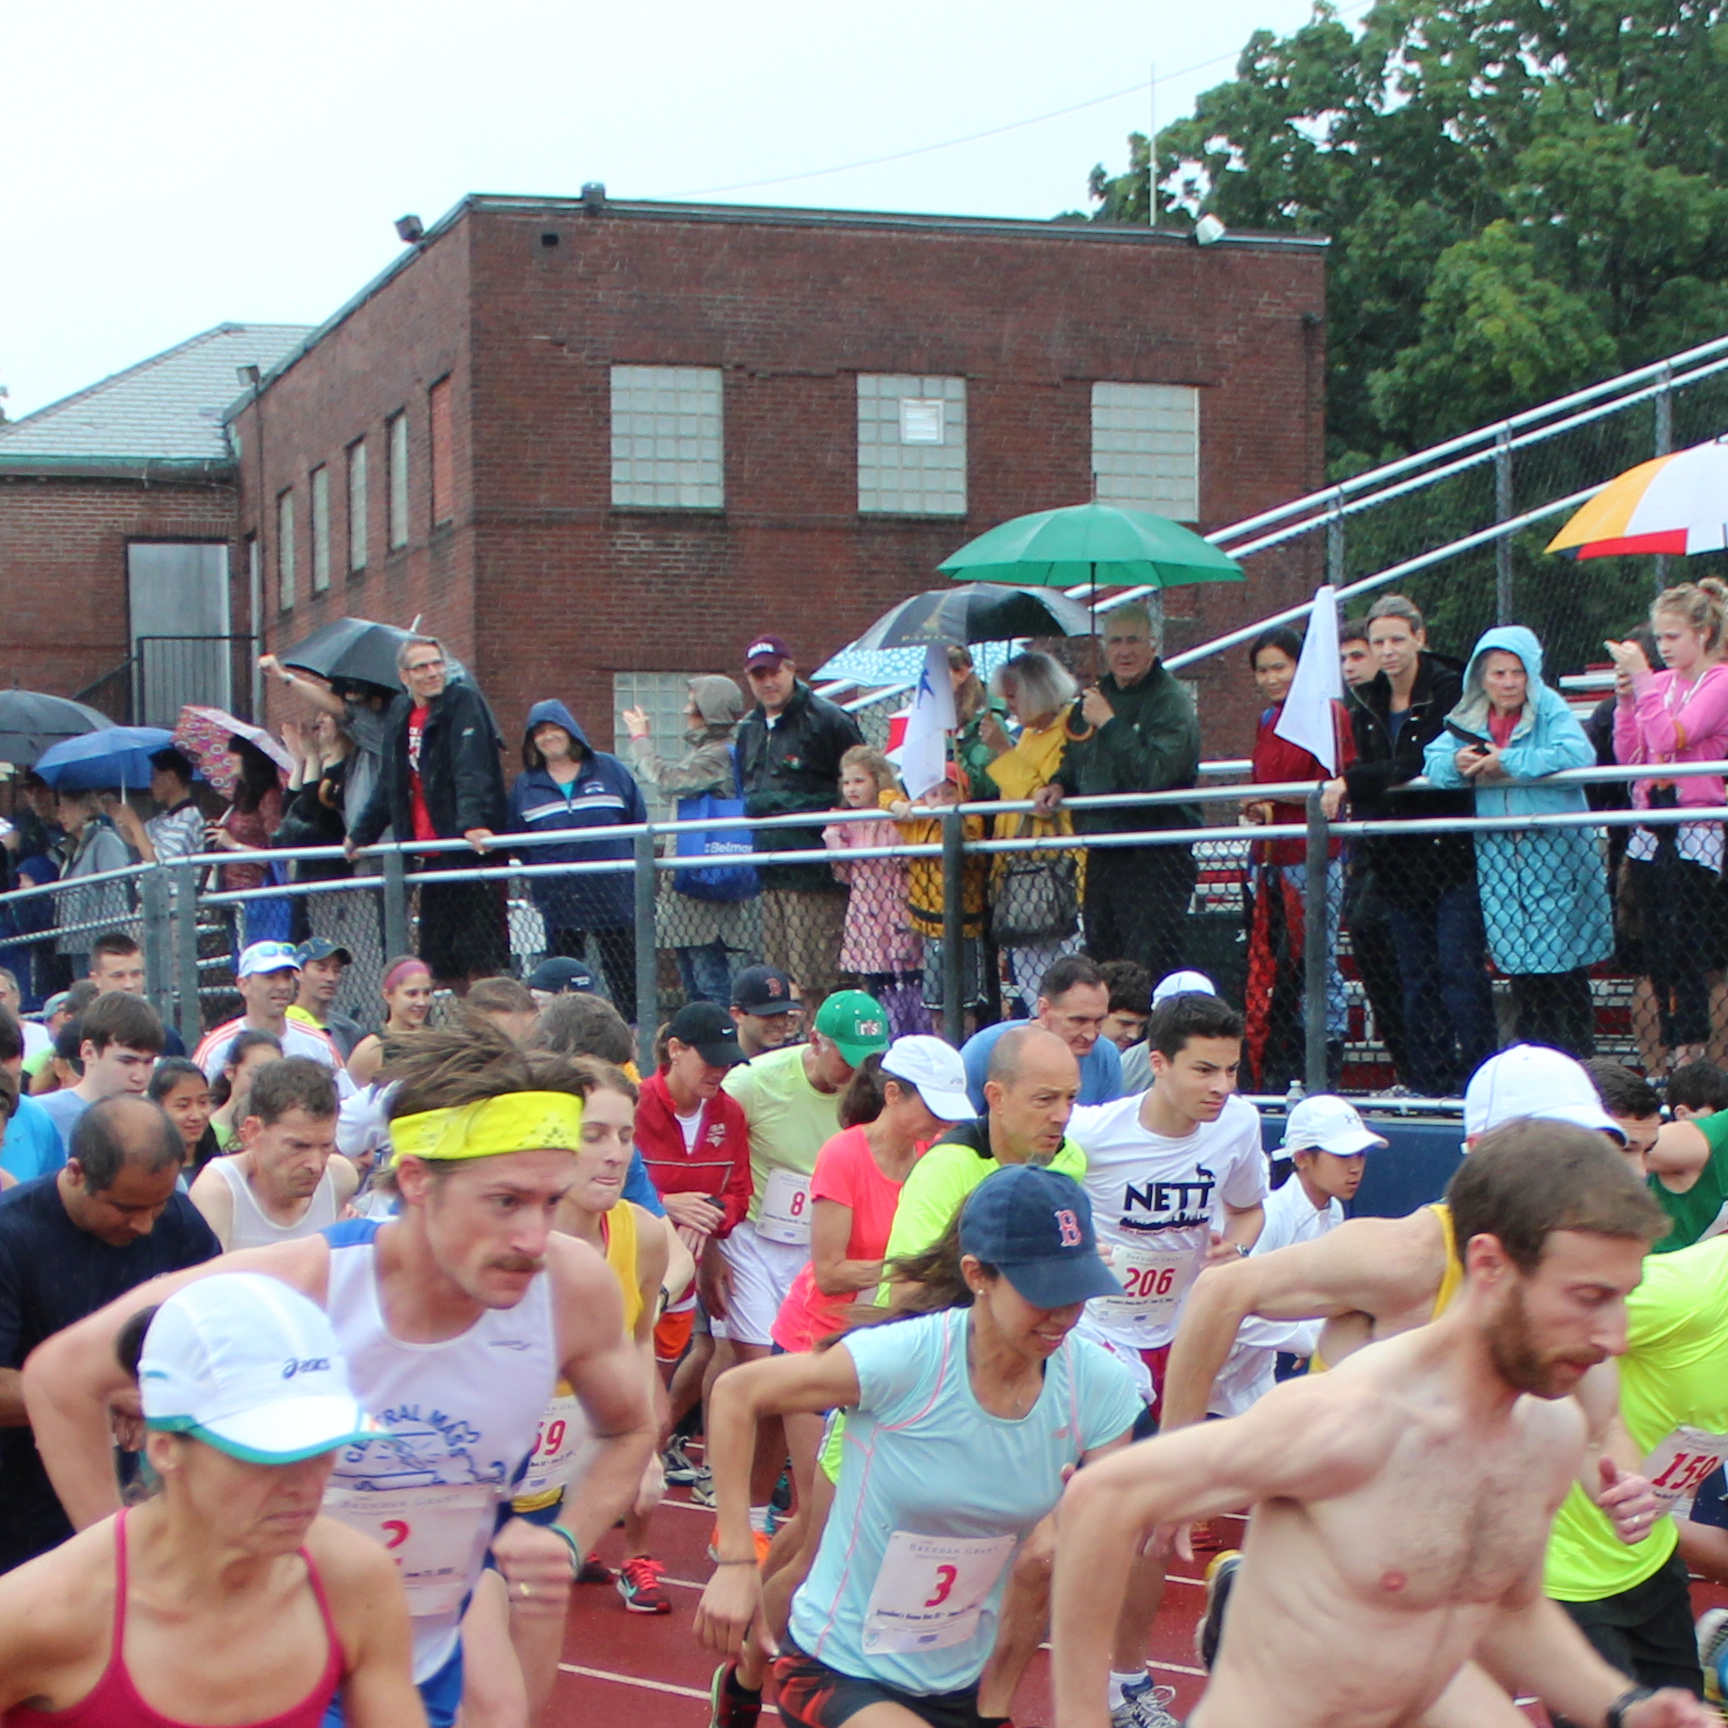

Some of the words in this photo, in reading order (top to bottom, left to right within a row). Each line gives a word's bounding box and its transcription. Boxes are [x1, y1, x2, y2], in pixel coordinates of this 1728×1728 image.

[789, 1191, 806, 1217] 8
[1123, 1181, 1217, 1212] NETT
[1054, 1208, 1083, 1248] B
[1123, 1267, 1176, 1299] 206
[1651, 1452, 1719, 1490] 159
[924, 1564, 958, 1608] 3
